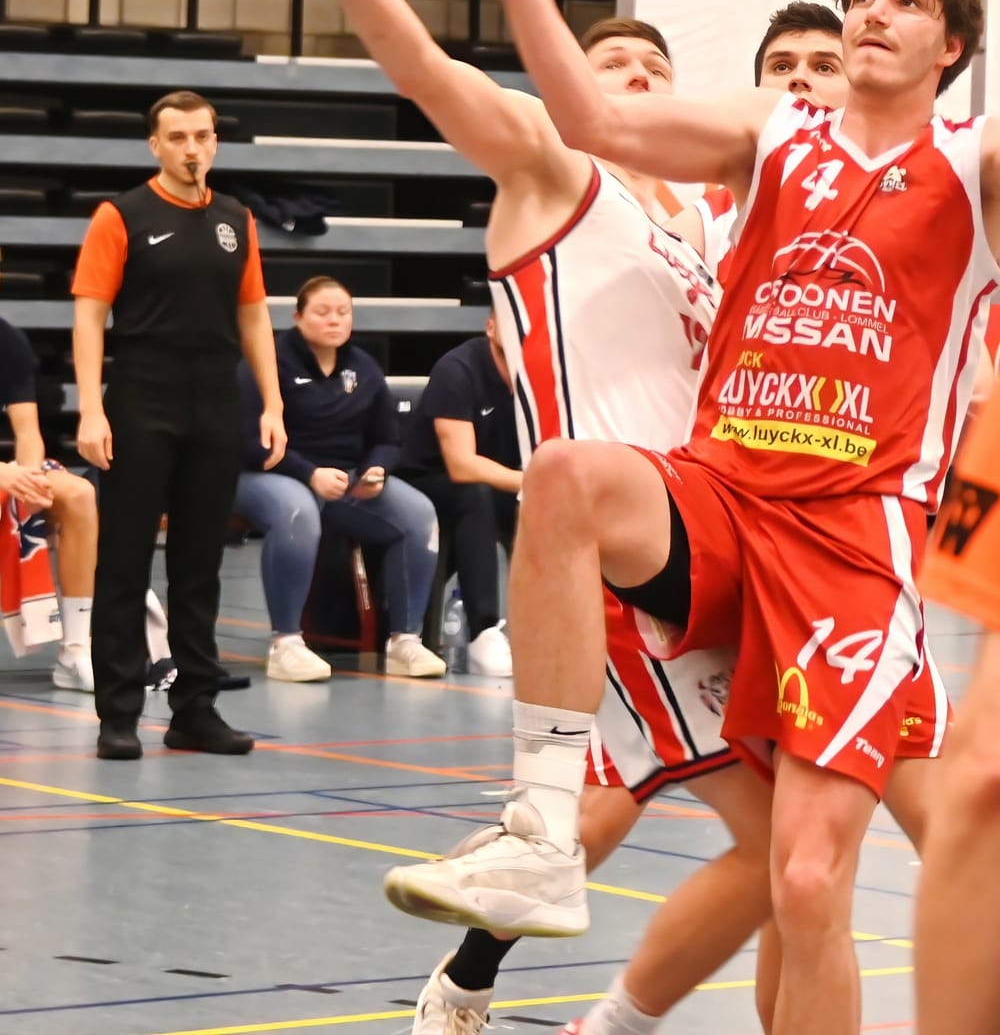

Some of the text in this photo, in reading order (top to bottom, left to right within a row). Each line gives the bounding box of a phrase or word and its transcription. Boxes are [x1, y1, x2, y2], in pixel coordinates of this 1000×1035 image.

[780, 143, 845, 211] 14
[840, 313, 889, 334] LOMMEL
[767, 408, 871, 435] PROFESSIONAL
[797, 616, 884, 685] 14
